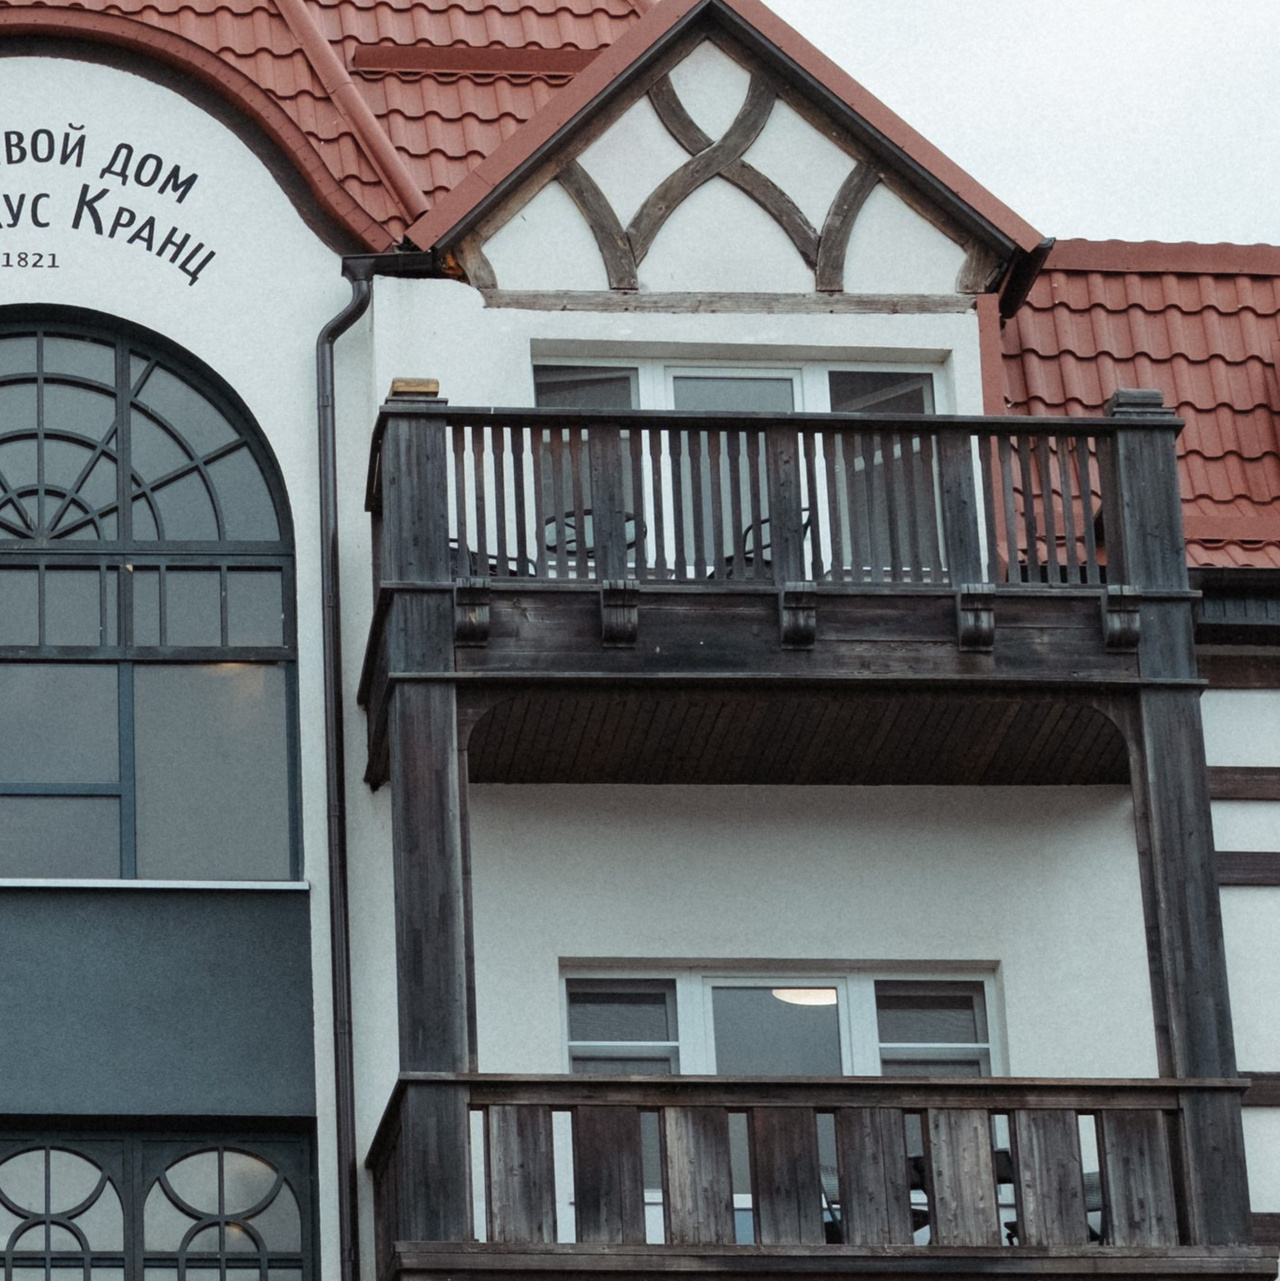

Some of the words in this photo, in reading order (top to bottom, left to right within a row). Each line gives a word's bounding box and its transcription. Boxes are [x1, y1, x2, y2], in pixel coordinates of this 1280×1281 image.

[99, 142, 199, 205] ДОМ
[1, 251, 61, 269] 1821
[71, 183, 217, 287] КРАНЦ
